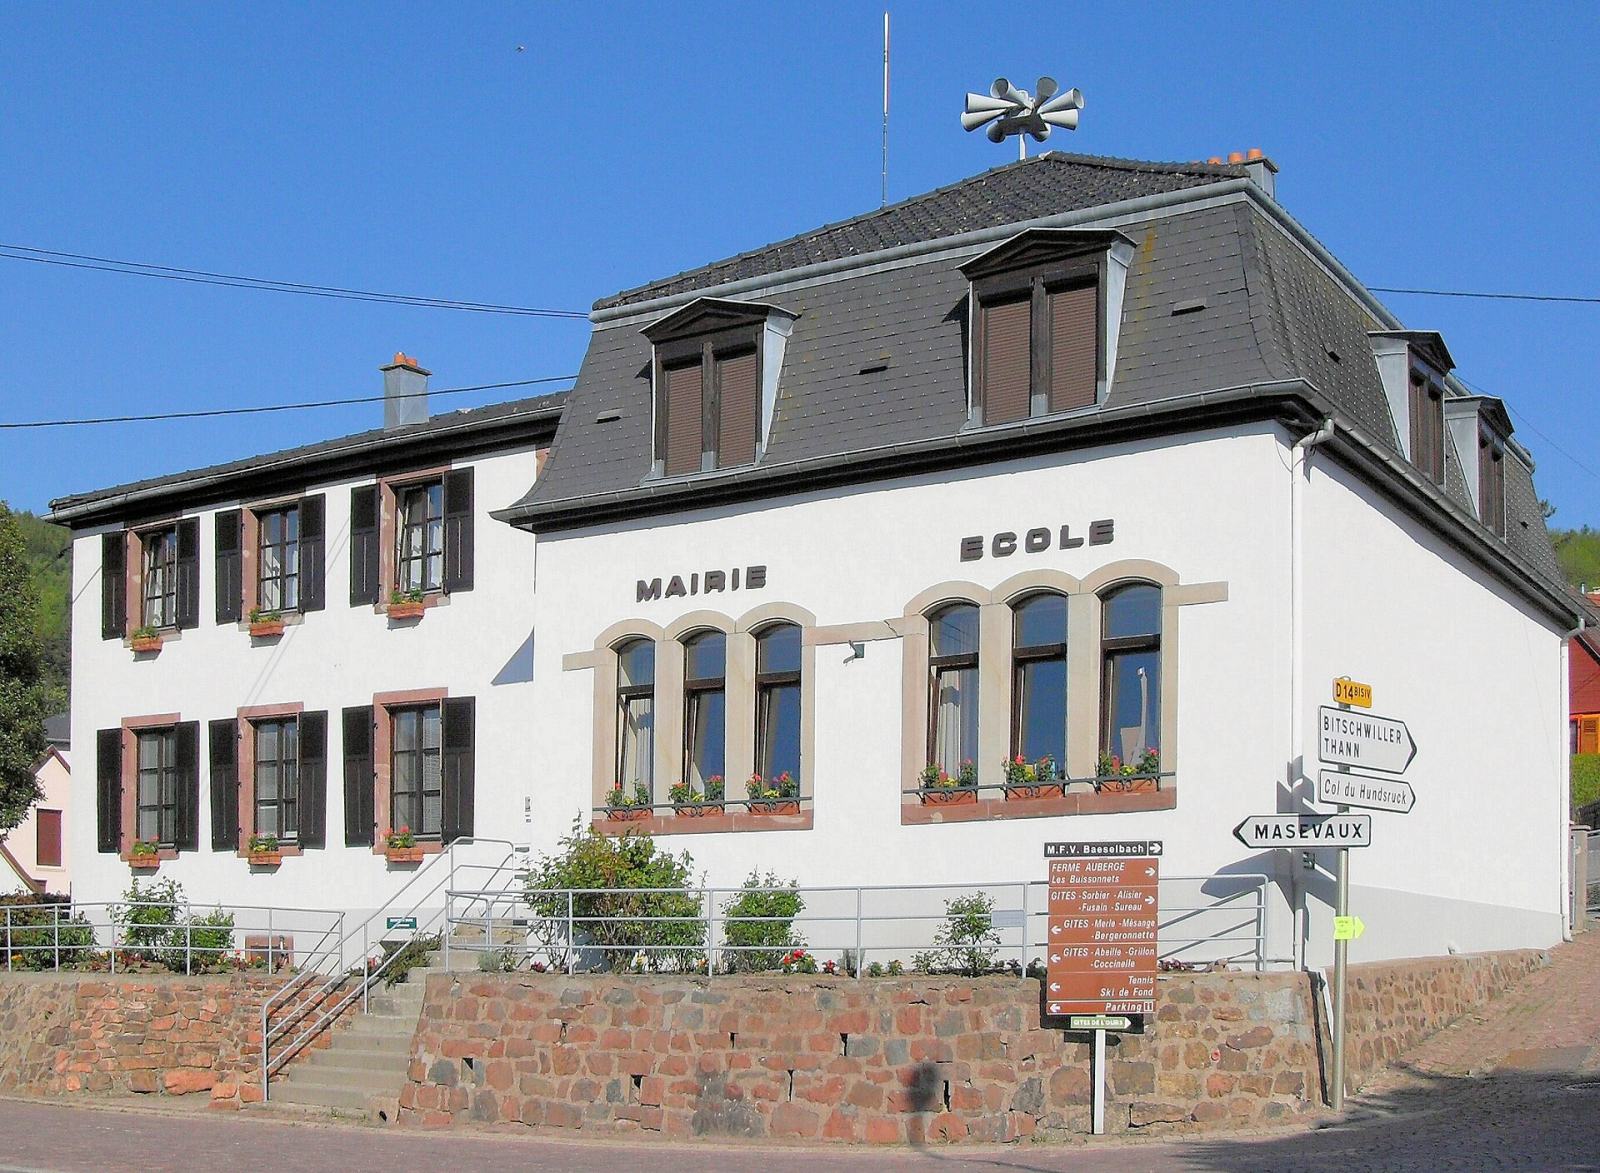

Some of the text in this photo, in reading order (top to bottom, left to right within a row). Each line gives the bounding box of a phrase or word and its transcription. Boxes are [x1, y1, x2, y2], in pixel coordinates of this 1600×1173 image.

[960, 519, 1114, 562] ECOLE
[636, 565, 767, 602] MAIRIE
[1324, 715, 1401, 744] BITSCHWILLER
[1324, 737, 1359, 758] THANN
[1324, 779, 1407, 804] Col du Hundsruck
[1254, 823, 1363, 839] MASEVAUX
[1047, 844, 1144, 854] M.F.V. Baeselbach
[1052, 862, 1125, 872] FERME AUBERGE
[1052, 874, 1120, 884] Les Buissonnets
[1051, 892, 1076, 900] GITES
[1064, 920, 1088, 929] GITES
[1063, 948, 1088, 957] GITES
[1129, 975, 1154, 984] Tennis
[1100, 986, 1153, 997] Ski de Fond
[1105, 1002, 1142, 1013] Parking
